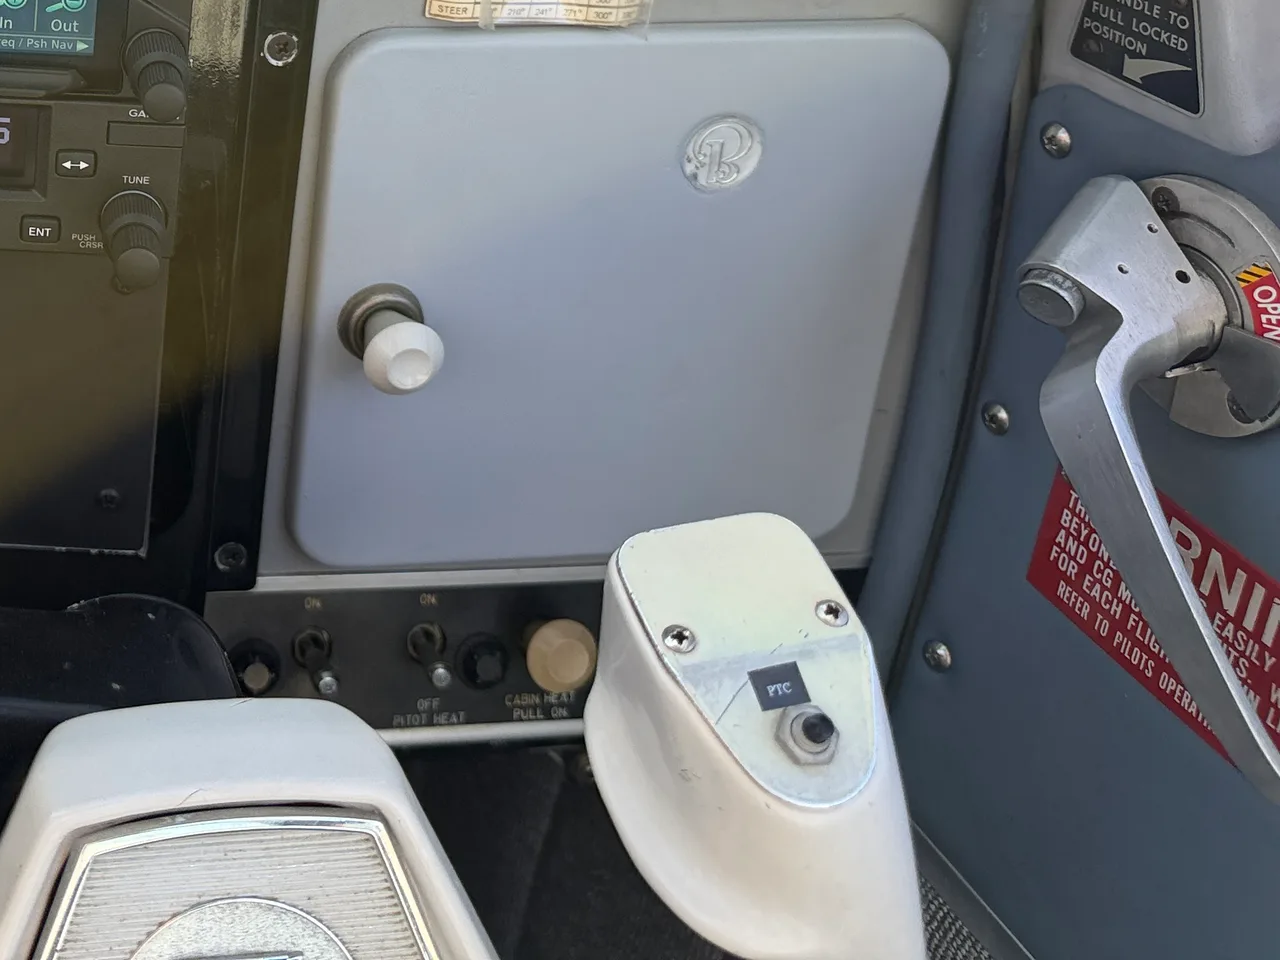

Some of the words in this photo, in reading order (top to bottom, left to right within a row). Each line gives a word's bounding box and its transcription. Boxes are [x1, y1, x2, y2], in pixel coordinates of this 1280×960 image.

[51, 19, 79, 32] Out
[1092, 1, 1124, 26] FULL
[1132, 18, 1188, 52] LOCKED
[1169, 10, 1189, 30] TO
[1083, 17, 1147, 56] POSITION
[122, 175, 150, 185] TUNE
[29, 227, 52, 237] ENT
[1057, 580, 1090, 621] REFER
[1094, 612, 1109, 636] TO
[1113, 631, 1155, 678] PILOTS
[1212, 612, 1276, 673] EASILY
[767, 682, 792, 697] PTC
[433, 711, 467, 725] HEAT
